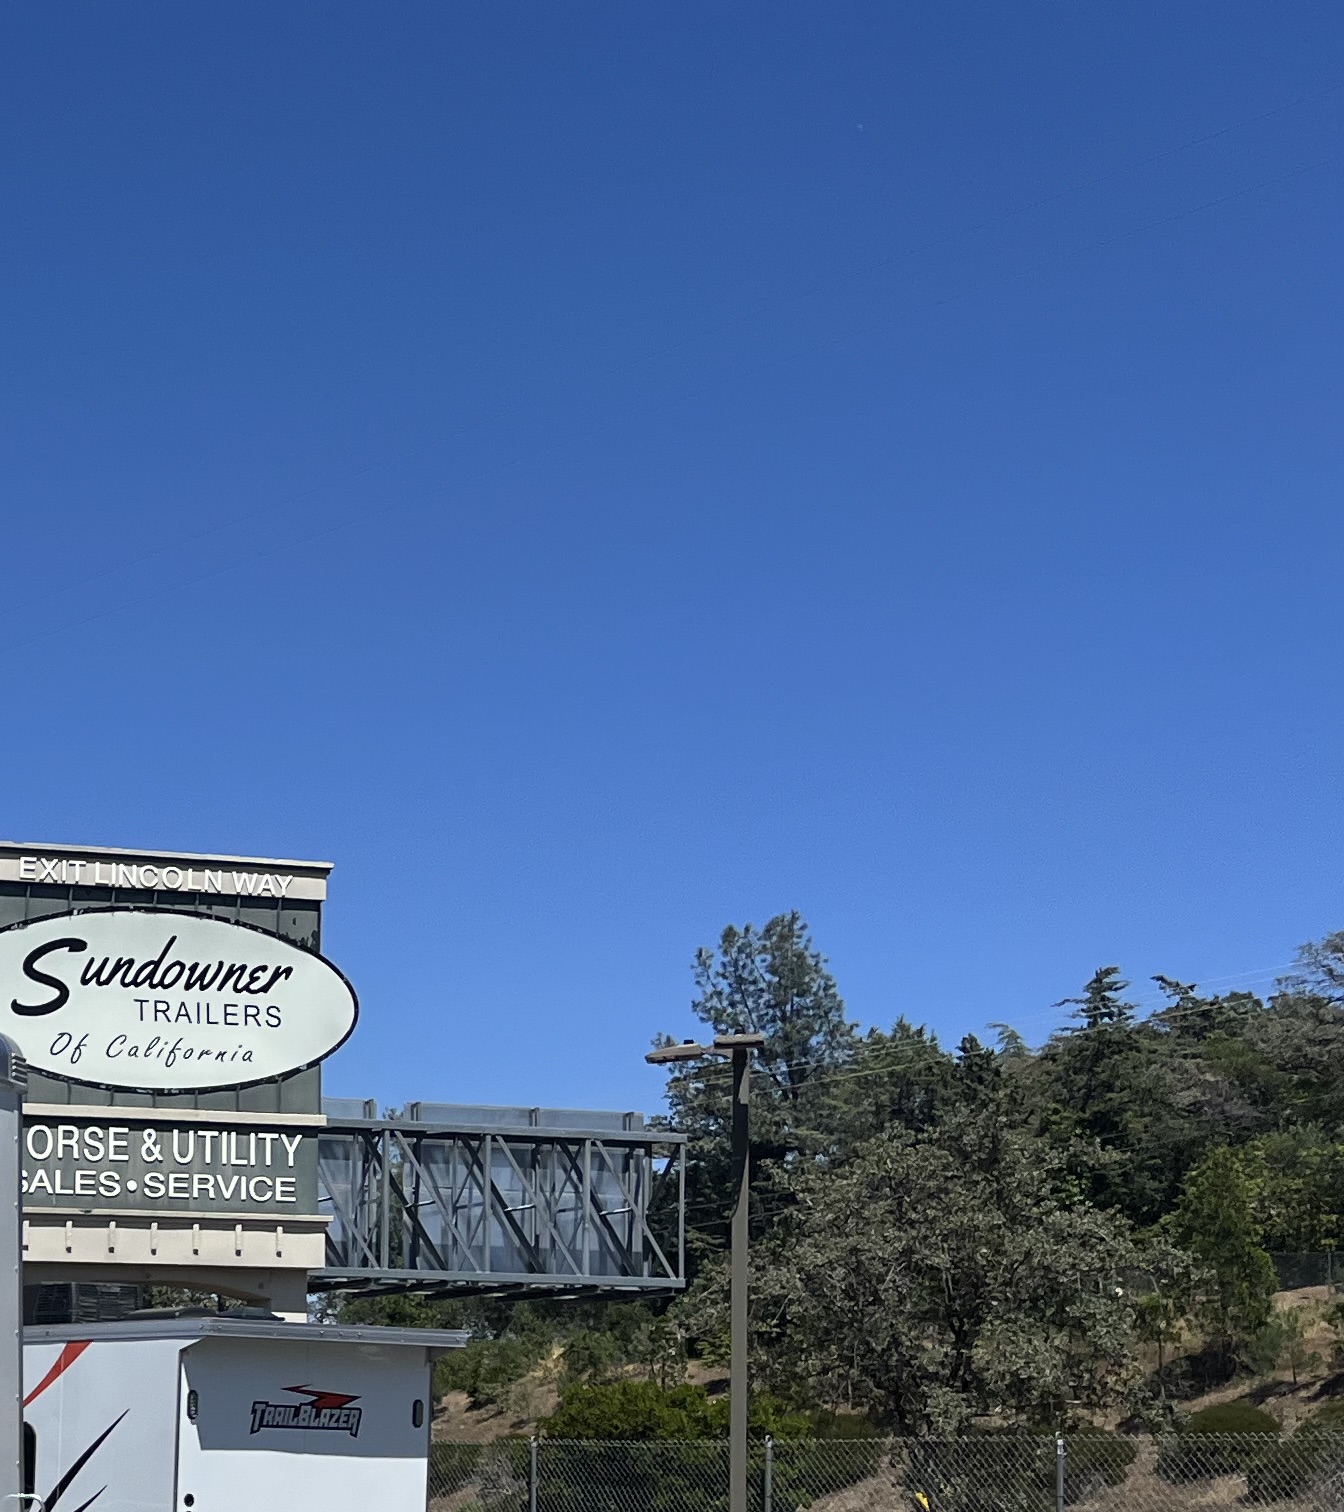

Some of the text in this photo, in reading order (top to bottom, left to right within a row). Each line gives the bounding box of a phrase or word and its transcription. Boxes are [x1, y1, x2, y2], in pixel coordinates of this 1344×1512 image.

[19, 856, 294, 898] EXIT LINCOLN WAY
[10, 935, 294, 1017] Sundowner
[133, 998, 283, 1028] TRAILERS
[49, 1032, 254, 1068] Of California
[26, 1124, 303, 1168] ORSE & UTILITY
[143, 1171, 297, 1203] SERVICE
